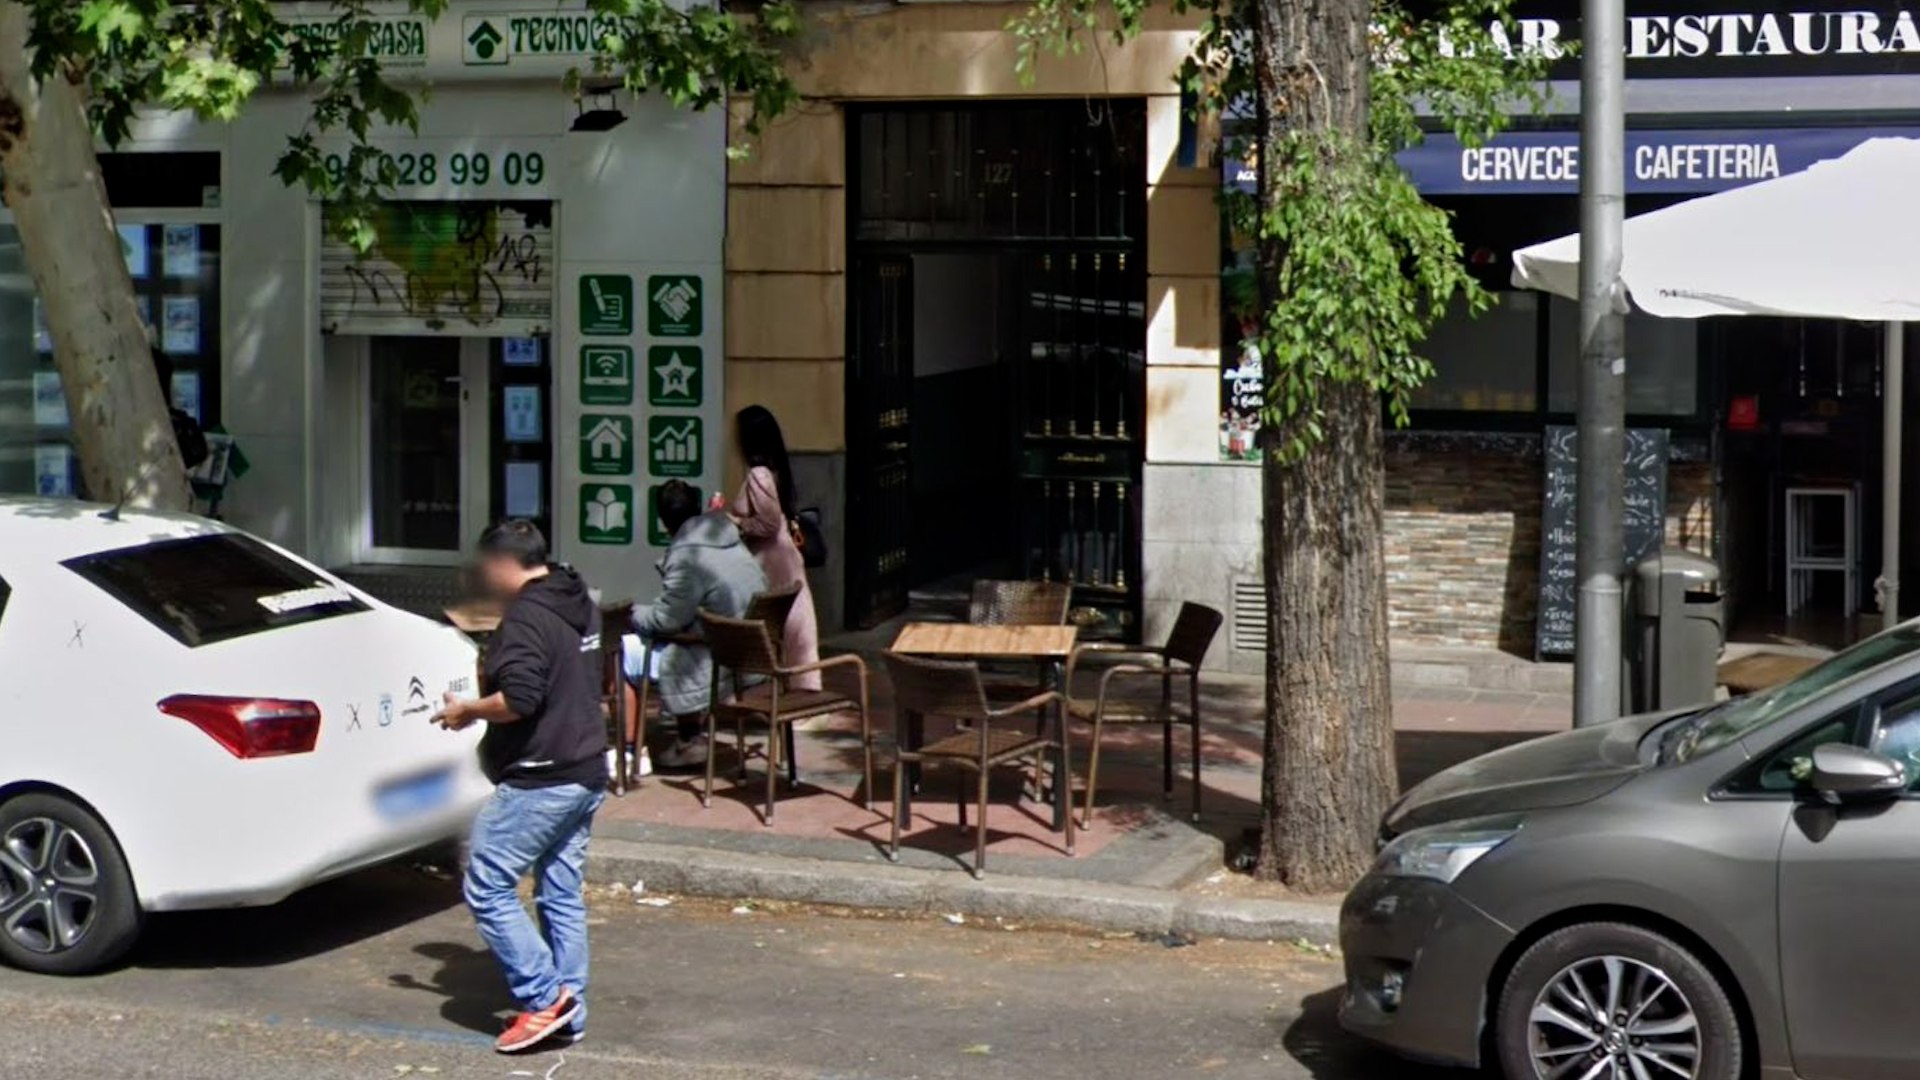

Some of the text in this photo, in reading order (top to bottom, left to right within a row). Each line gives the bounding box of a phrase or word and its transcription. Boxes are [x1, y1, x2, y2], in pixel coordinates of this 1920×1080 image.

[511, 16, 634, 53] TECNOC
[1578, 10, 1920, 58] ESTAURA
[450, 153, 490, 185] 99
[503, 152, 544, 185] 09
[984, 162, 1012, 183] 127
[1461, 144, 1779, 181] CERVECE CAFETERIA
